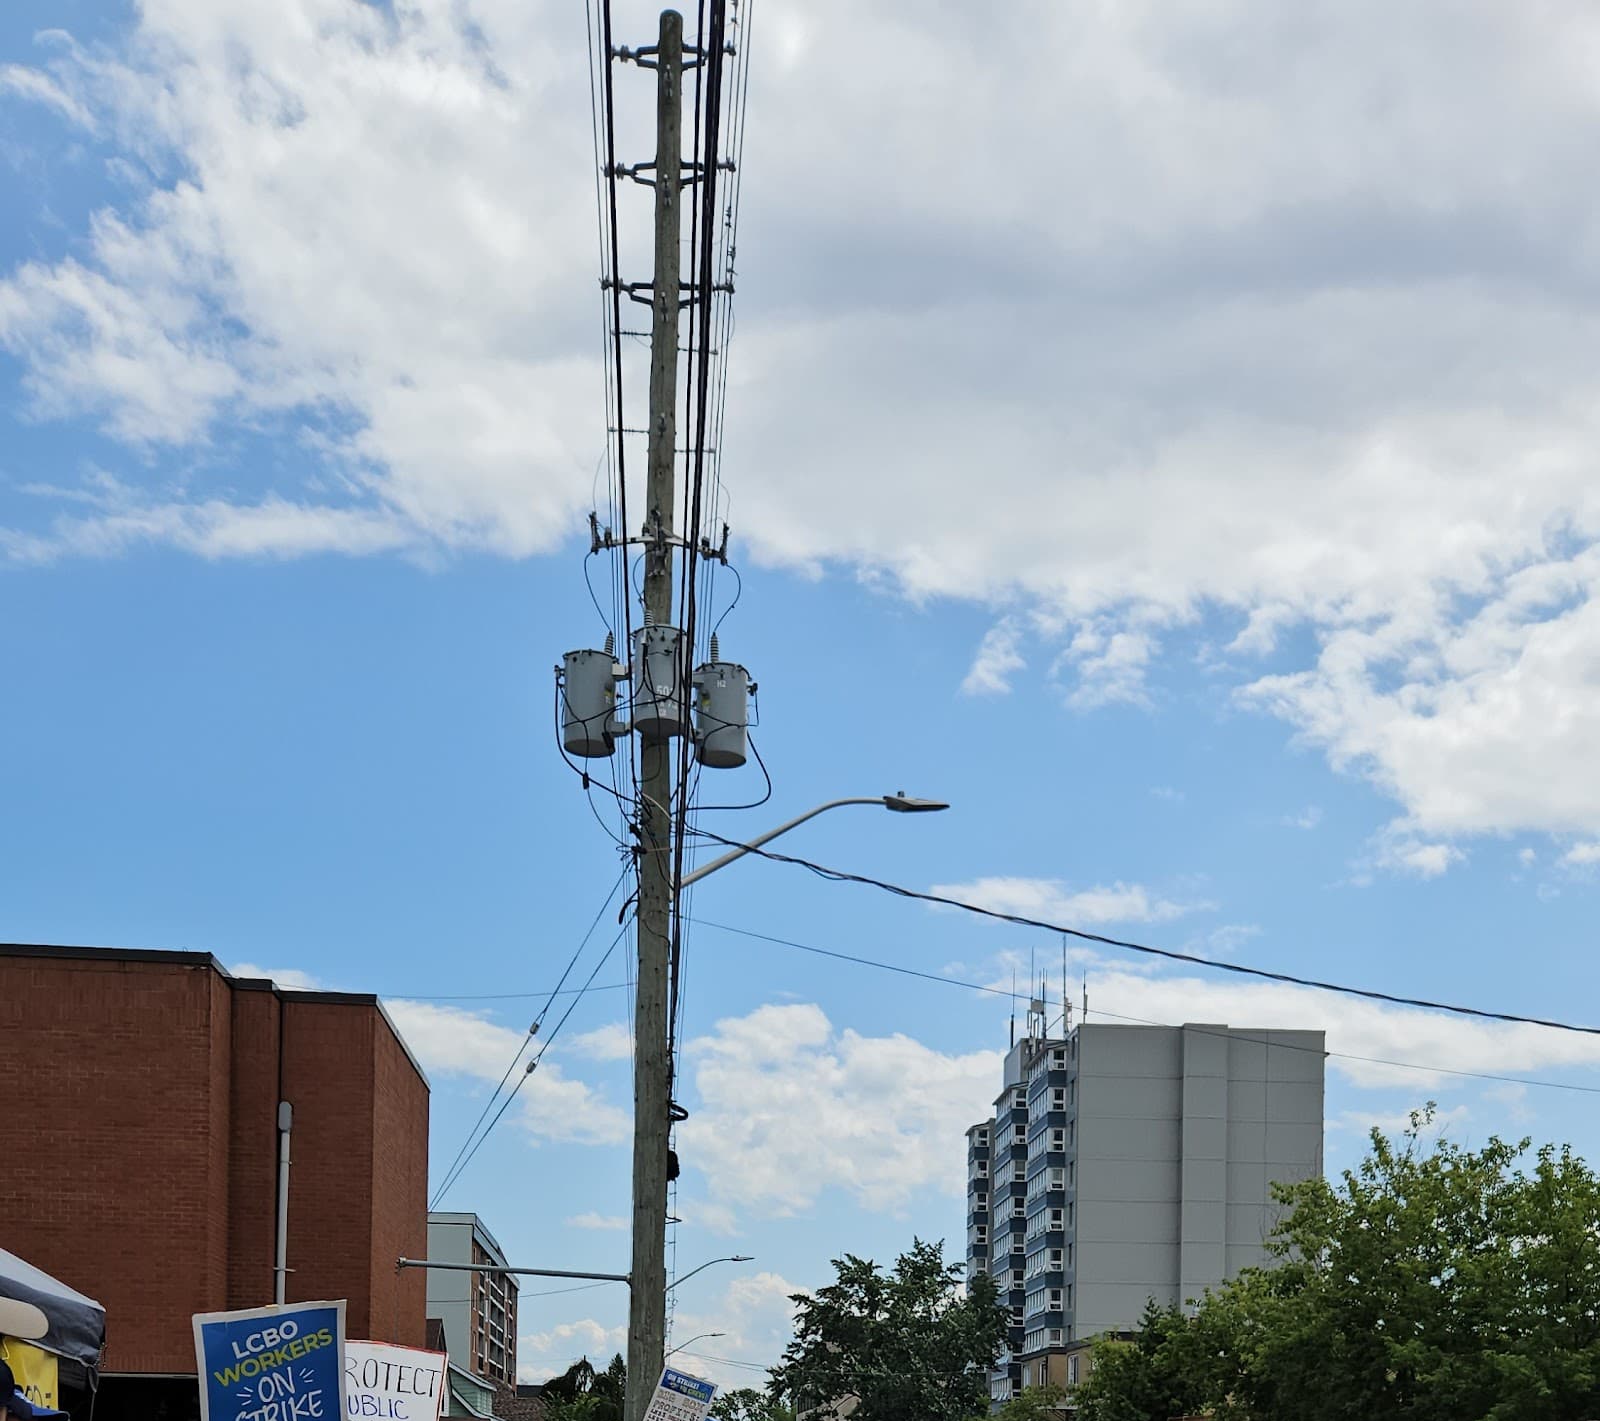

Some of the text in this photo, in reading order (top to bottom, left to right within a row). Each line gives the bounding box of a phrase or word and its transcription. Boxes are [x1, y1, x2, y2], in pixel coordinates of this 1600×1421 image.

[214, 1328, 333, 1387] WORKERS
[232, 1320, 298, 1359] LCBO
[258, 1366, 296, 1403] ON
[345, 1356, 441, 1397] ROTECT
[348, 1394, 409, 1419] UBLIC
